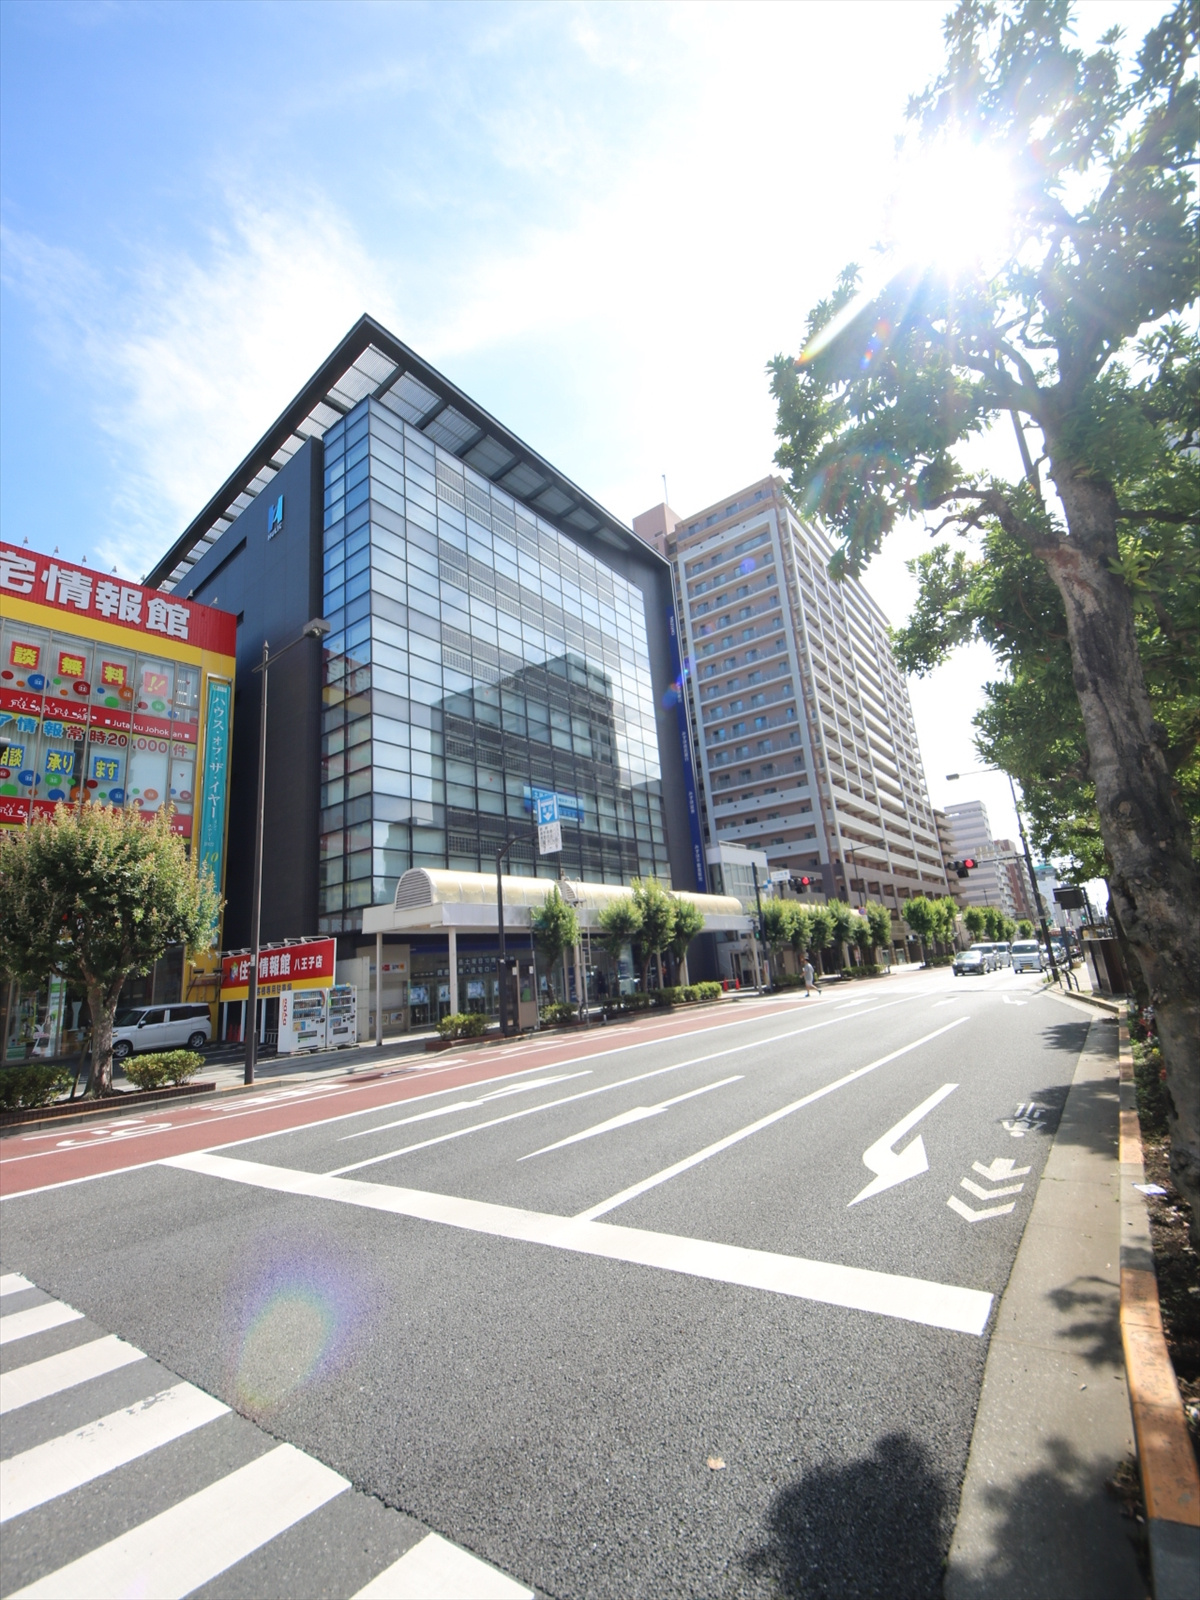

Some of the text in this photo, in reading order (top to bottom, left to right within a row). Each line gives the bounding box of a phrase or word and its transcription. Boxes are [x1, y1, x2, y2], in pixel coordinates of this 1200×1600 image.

[0, 551, 191, 640] 宅情報館
[239, 953, 323, 981] 住情報館 八王子店
